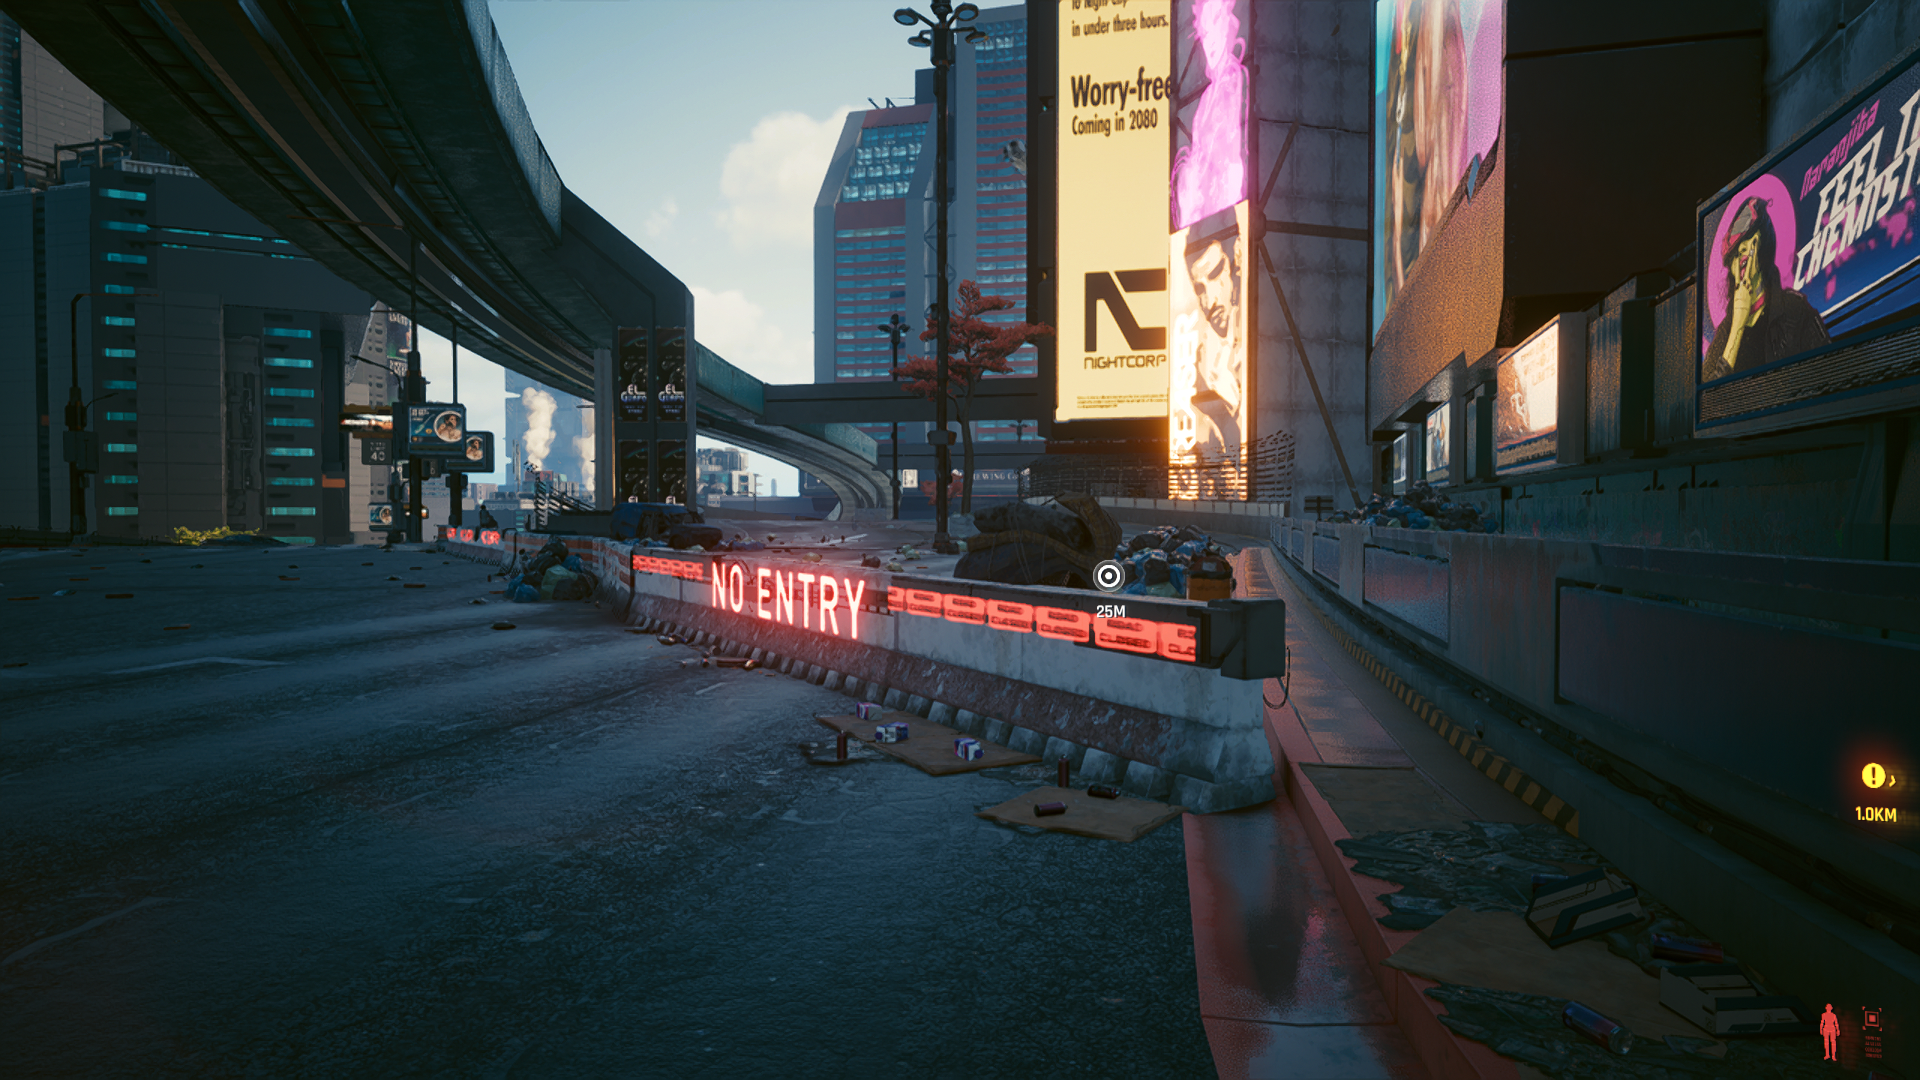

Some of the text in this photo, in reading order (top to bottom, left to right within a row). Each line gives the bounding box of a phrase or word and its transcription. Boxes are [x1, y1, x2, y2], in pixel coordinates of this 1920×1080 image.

[1072, 10, 1169, 37] in under three hours.
[1071, 66, 1171, 111] Worry-free
[1072, 108, 1158, 137] Coming in 2080
[1814, 125, 1885, 236] FEEL
[1084, 354, 1167, 370] NIGHTCORP
[371, 451, 386, 461] 40
[712, 562, 744, 614] NO
[757, 567, 865, 640] ENTRY
